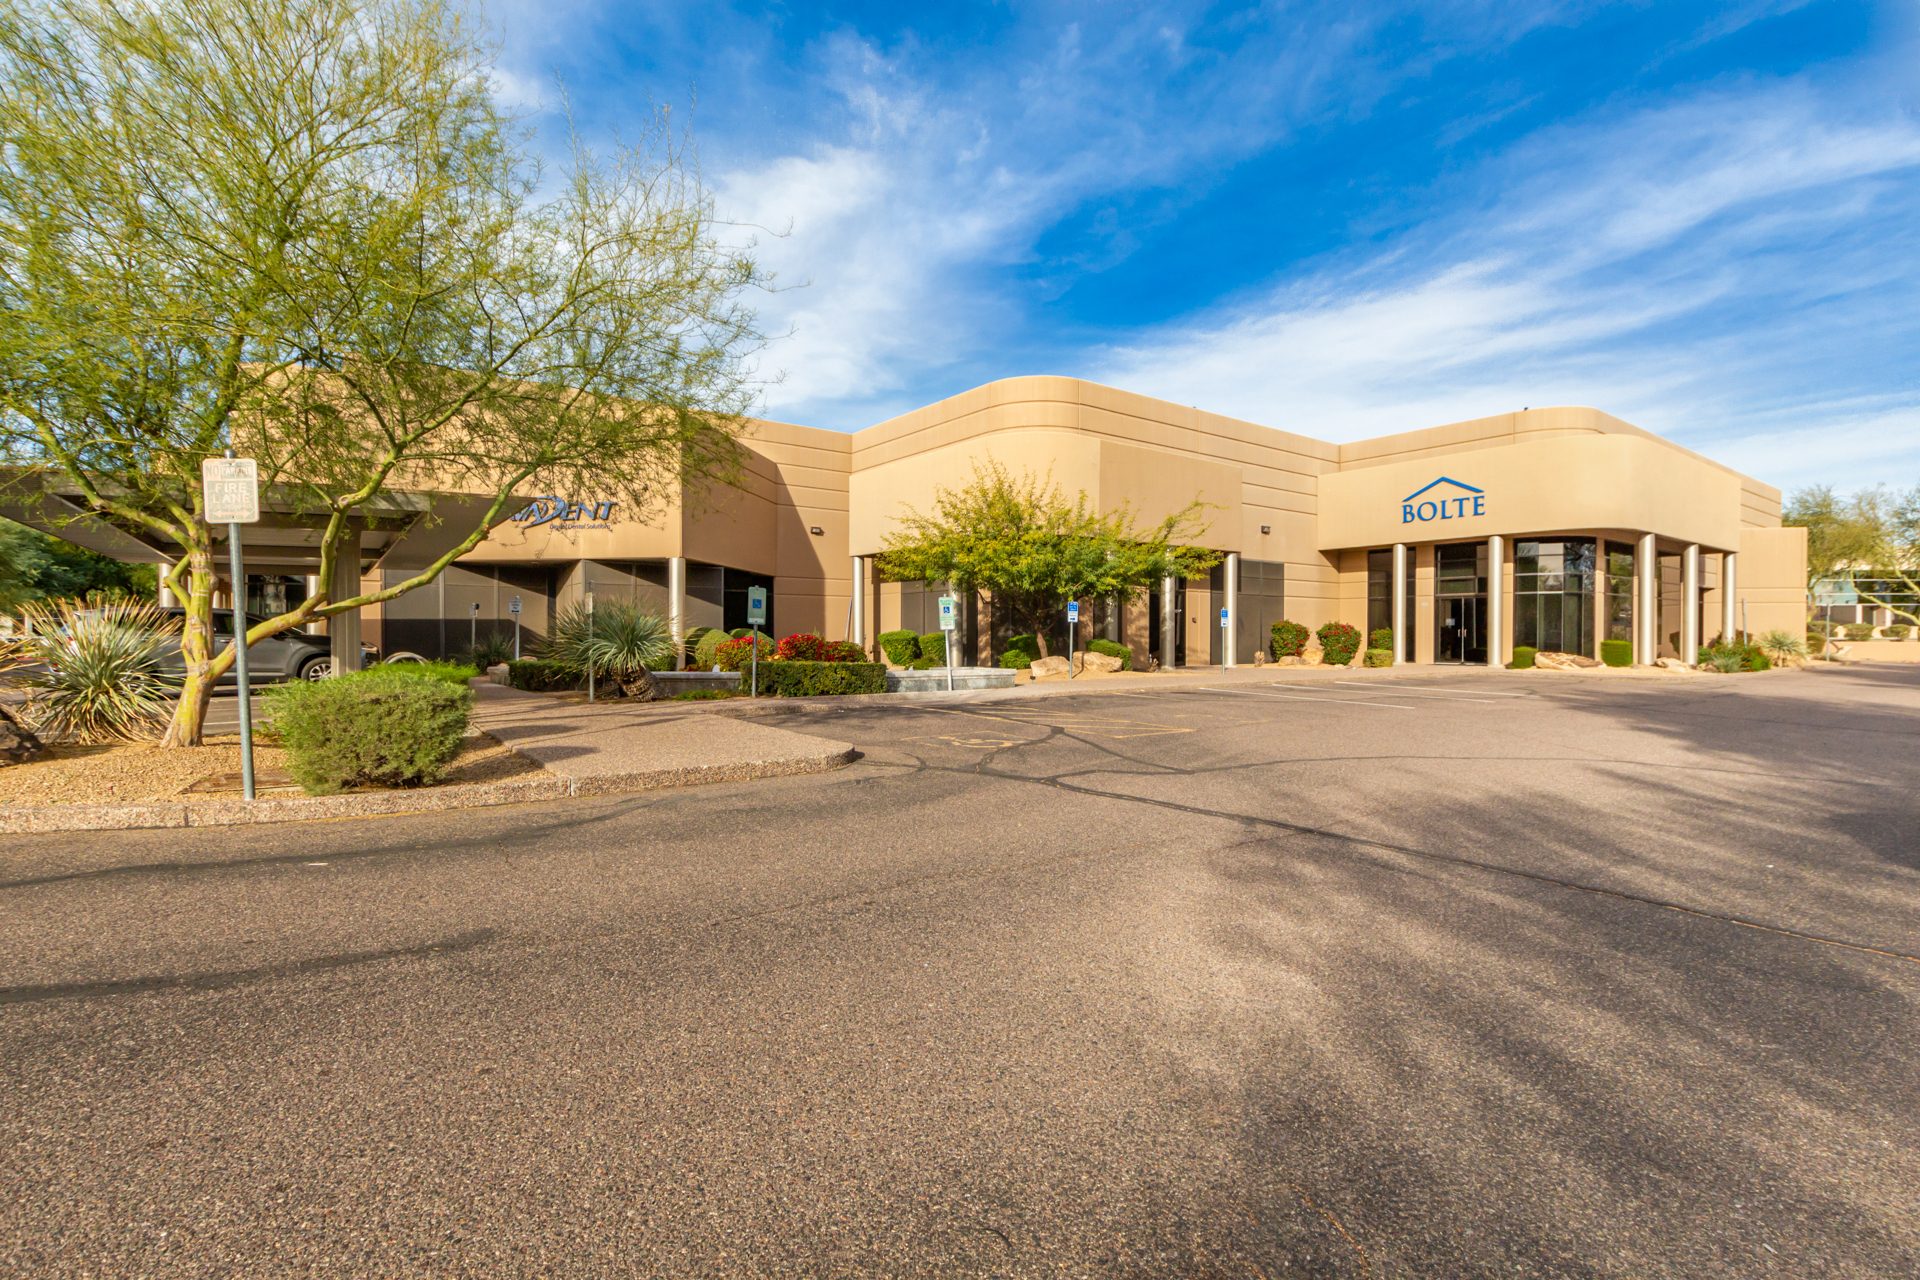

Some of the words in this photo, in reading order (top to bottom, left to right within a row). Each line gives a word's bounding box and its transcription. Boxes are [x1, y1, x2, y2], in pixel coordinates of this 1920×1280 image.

[215, 482, 247, 493] FIRE
[212, 493, 250, 504] LANE
[1402, 496, 1485, 524] BOLTE
